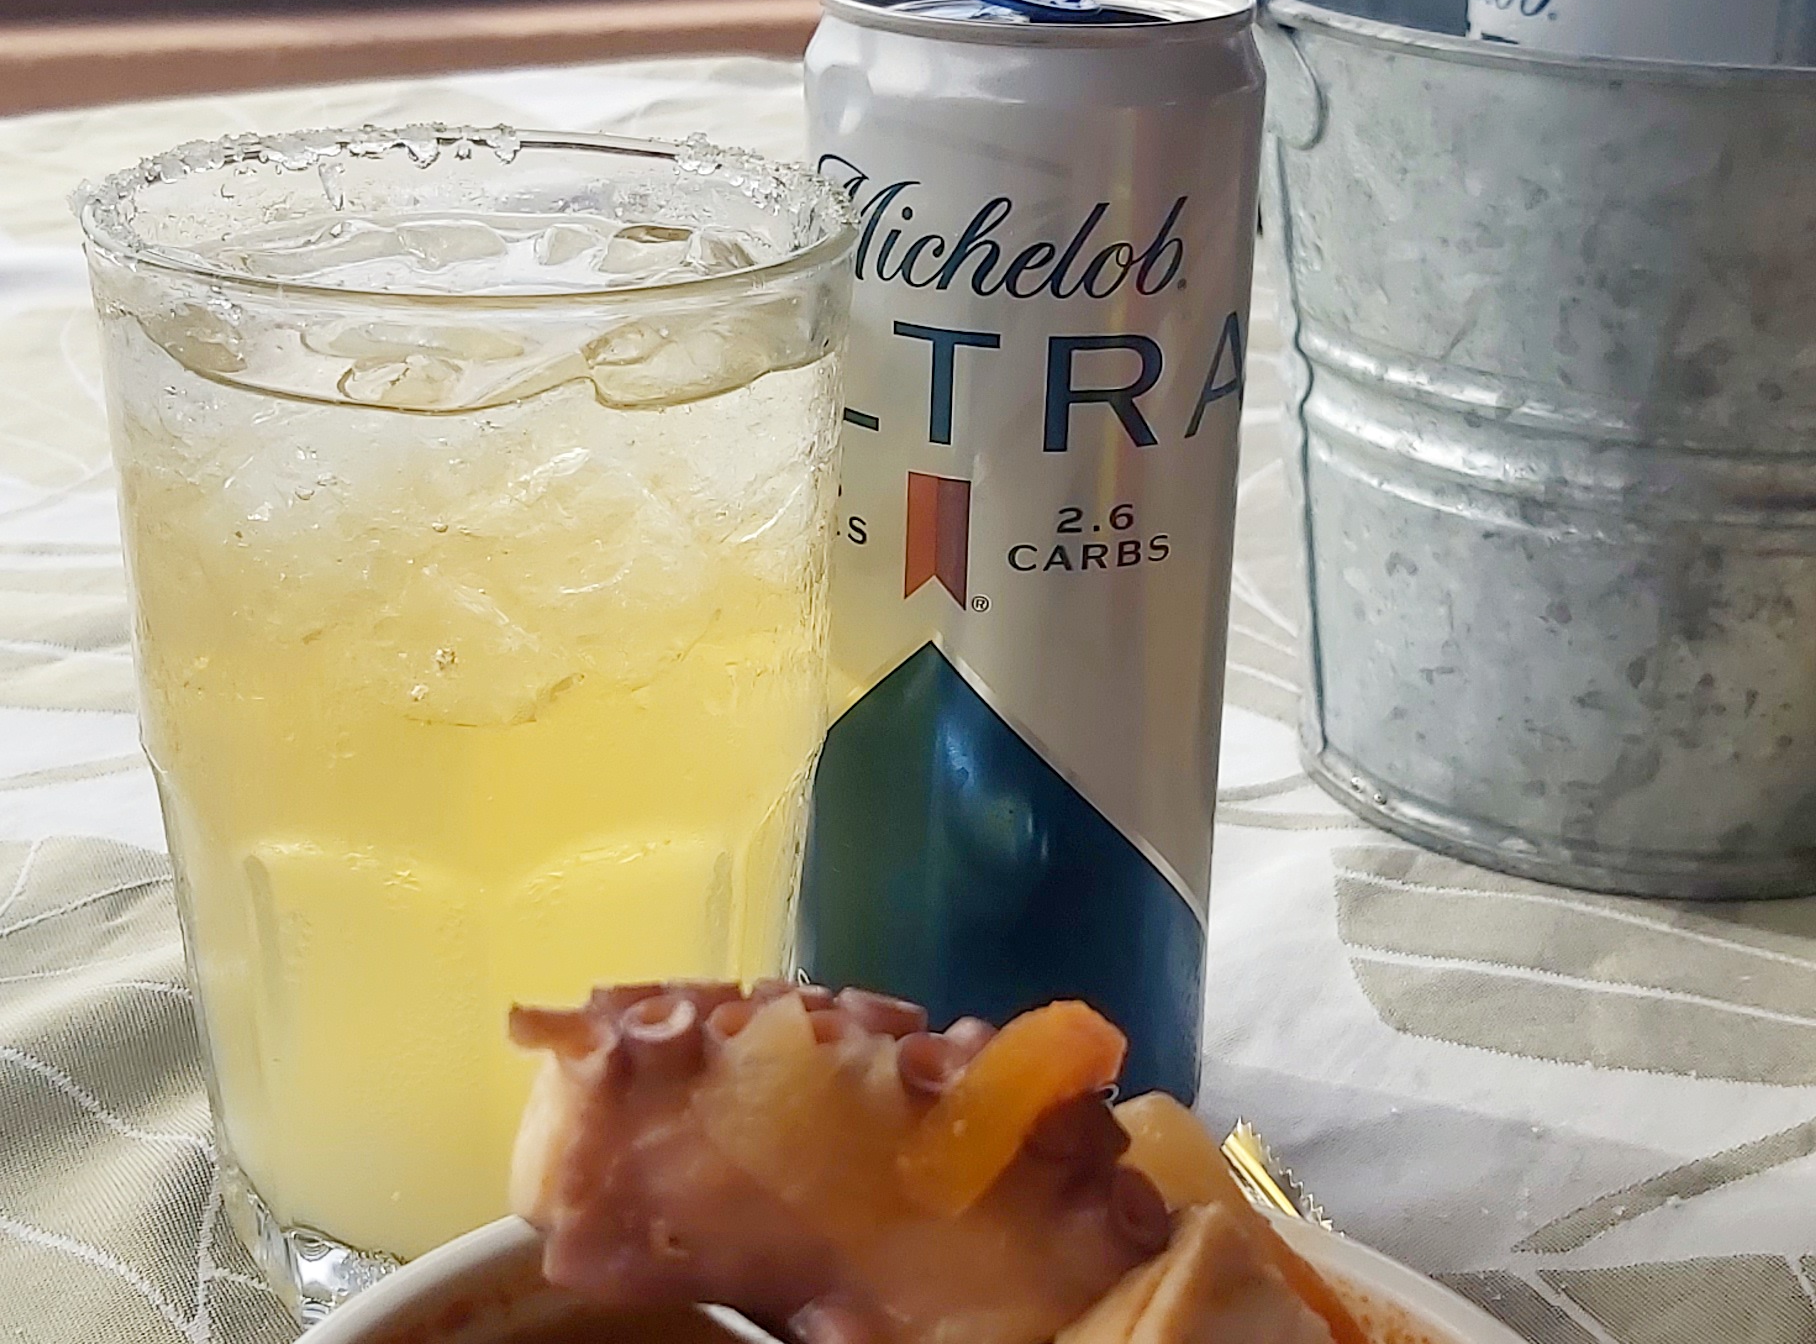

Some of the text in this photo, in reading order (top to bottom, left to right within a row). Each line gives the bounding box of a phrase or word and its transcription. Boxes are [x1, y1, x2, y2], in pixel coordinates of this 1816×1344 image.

[843, 311, 1244, 453] TRA
[1057, 503, 1135, 533] 2.6
[1008, 534, 1170, 572] CARBS
